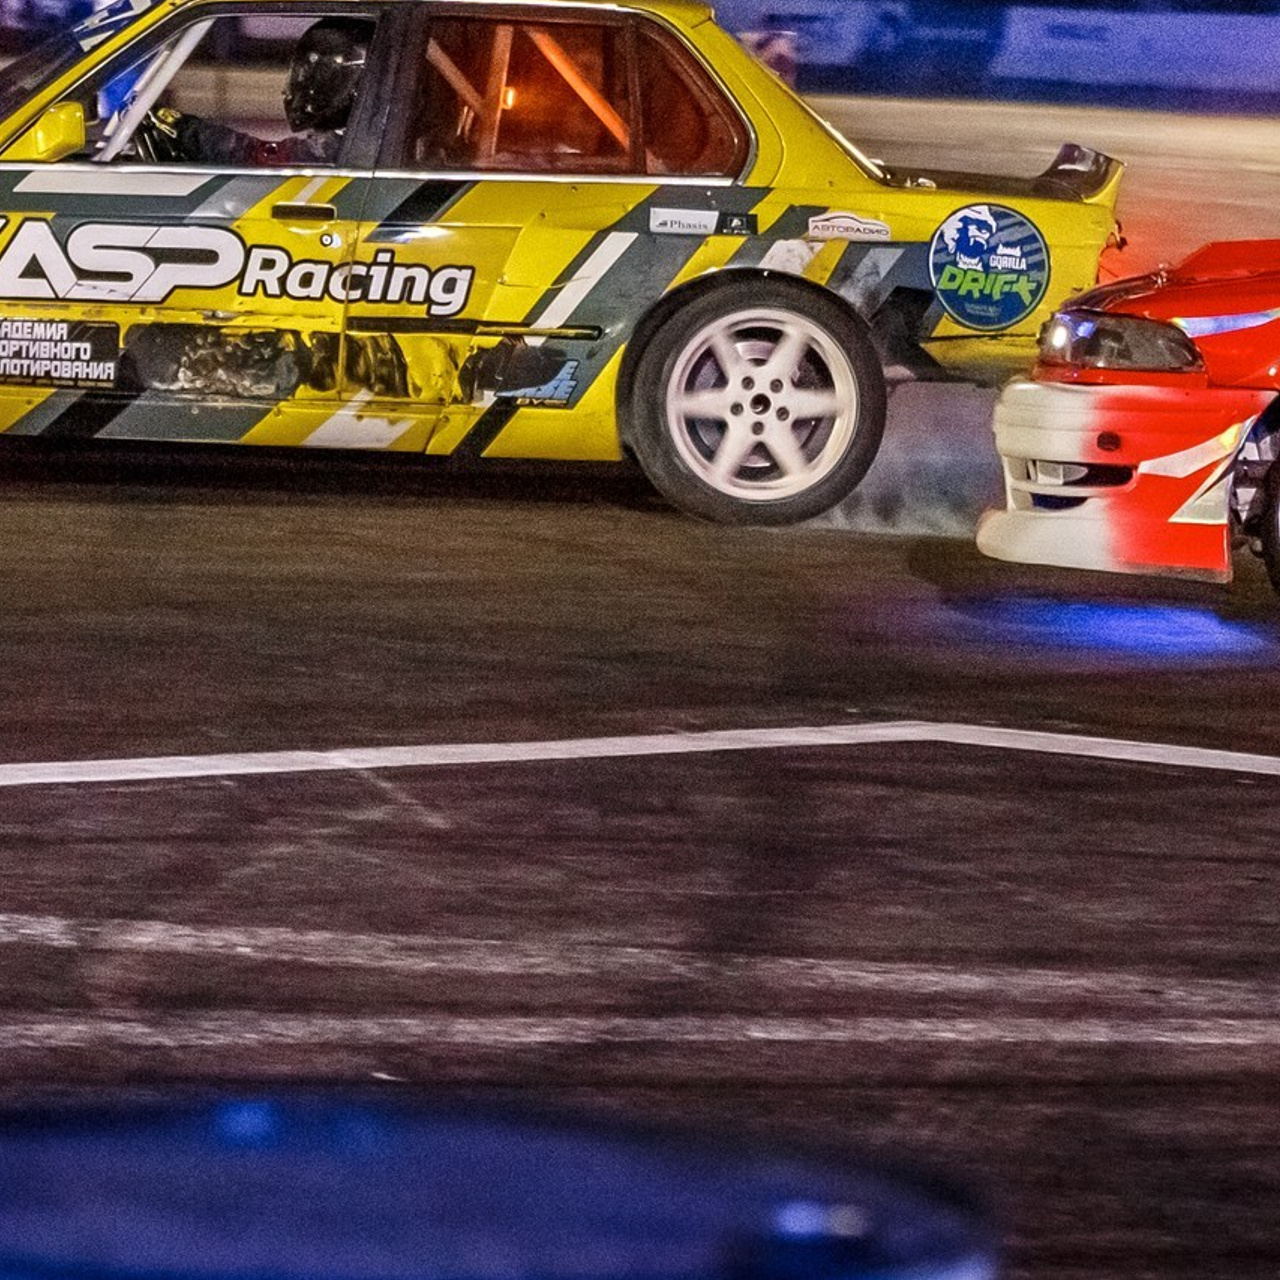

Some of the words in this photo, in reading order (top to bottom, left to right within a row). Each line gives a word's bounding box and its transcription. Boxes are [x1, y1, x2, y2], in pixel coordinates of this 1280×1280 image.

[670, 219, 708, 230] Phasis
[989, 254, 1027, 271] GORILLA
[241, 248, 472, 316] Racing
[936, 264, 1037, 307] DRIFT
[0, 321, 68, 341] АДЕМИЯ
